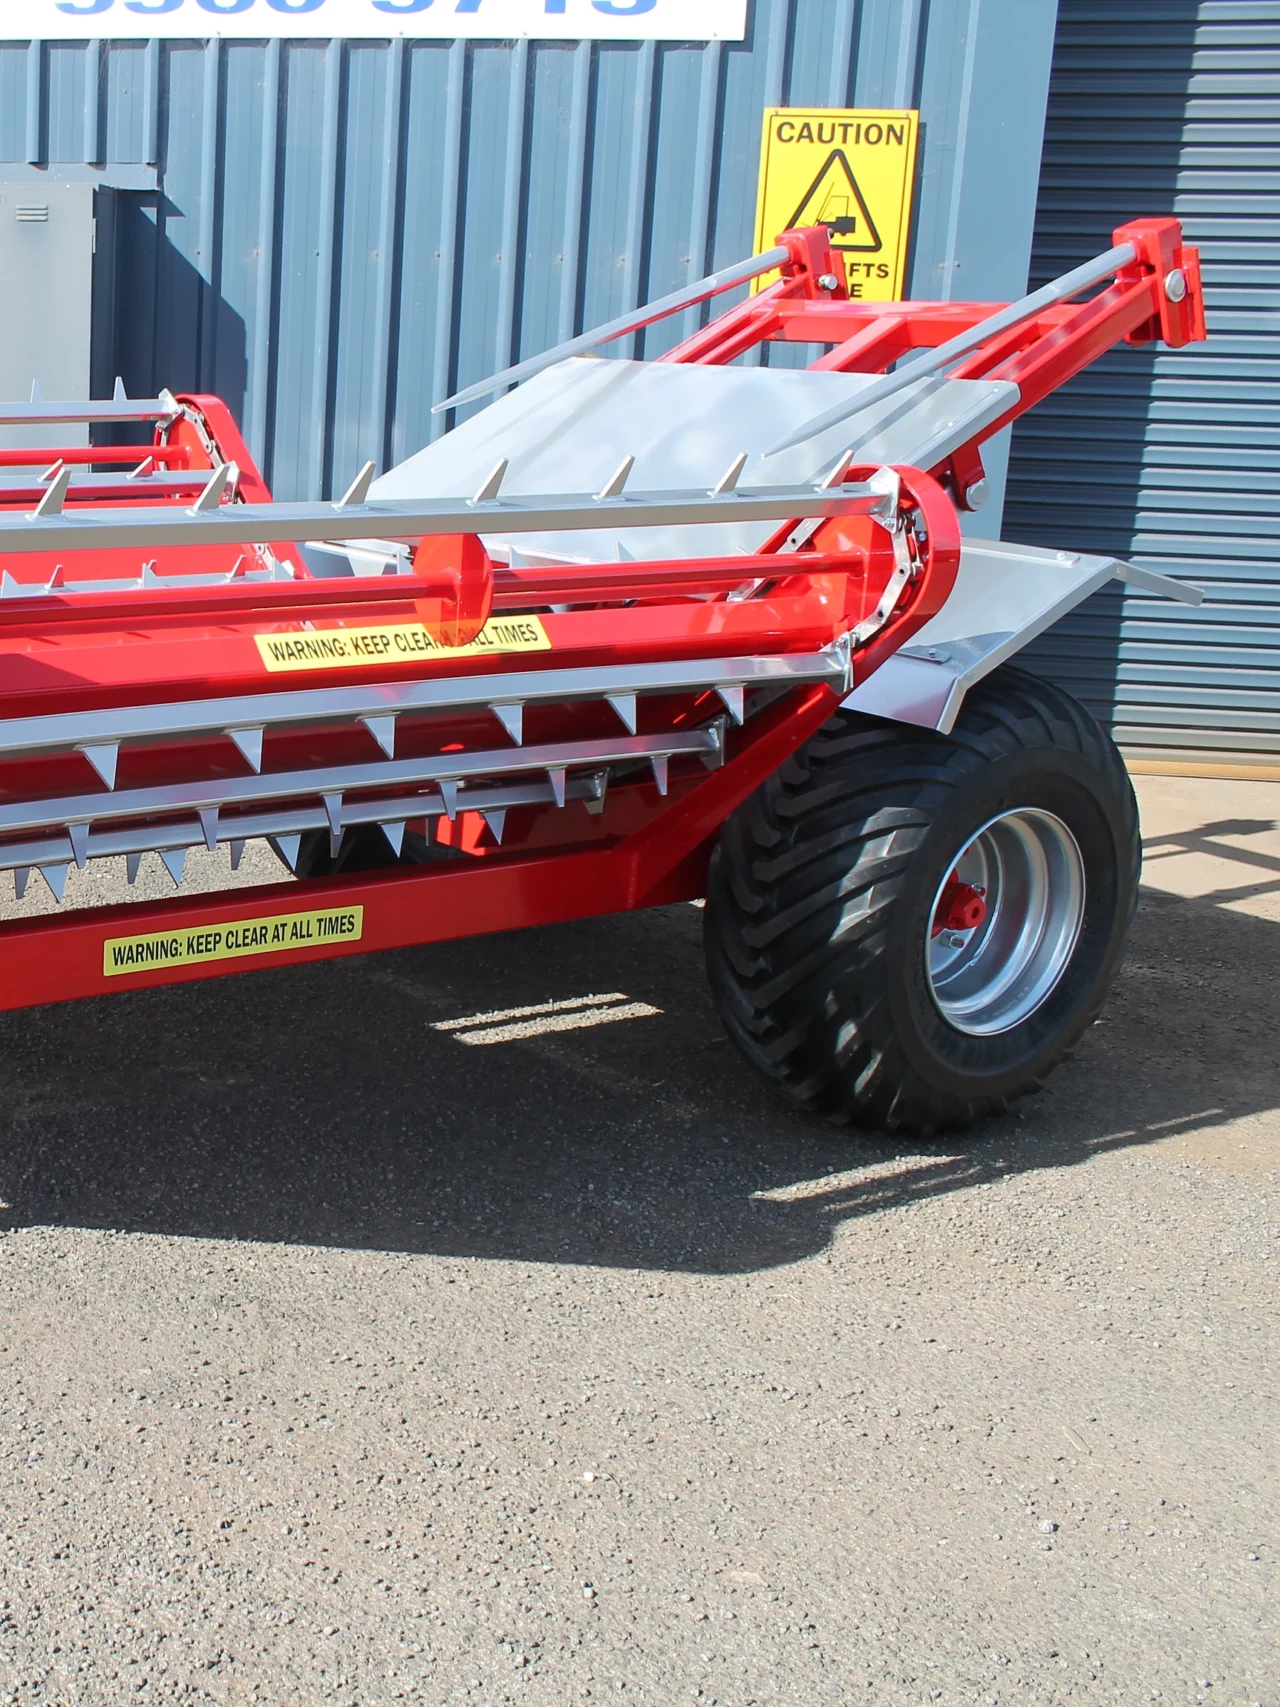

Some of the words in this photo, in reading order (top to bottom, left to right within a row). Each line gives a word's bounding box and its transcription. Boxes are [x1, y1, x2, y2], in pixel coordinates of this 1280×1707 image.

[776, 121, 904, 145] CAUTION
[844, 262, 889, 279] FTS
[267, 638, 350, 662] WARNING:
[353, 634, 390, 656] KEEP
[491, 623, 539, 645] TIMES
[112, 938, 183, 966] WARNING:
[186, 932, 222, 955] KEEP
[225, 925, 268, 949] CLEAR
[271, 922, 288, 943] AT
[290, 919, 313, 941] ALL
[316, 914, 355, 937] TIMES
